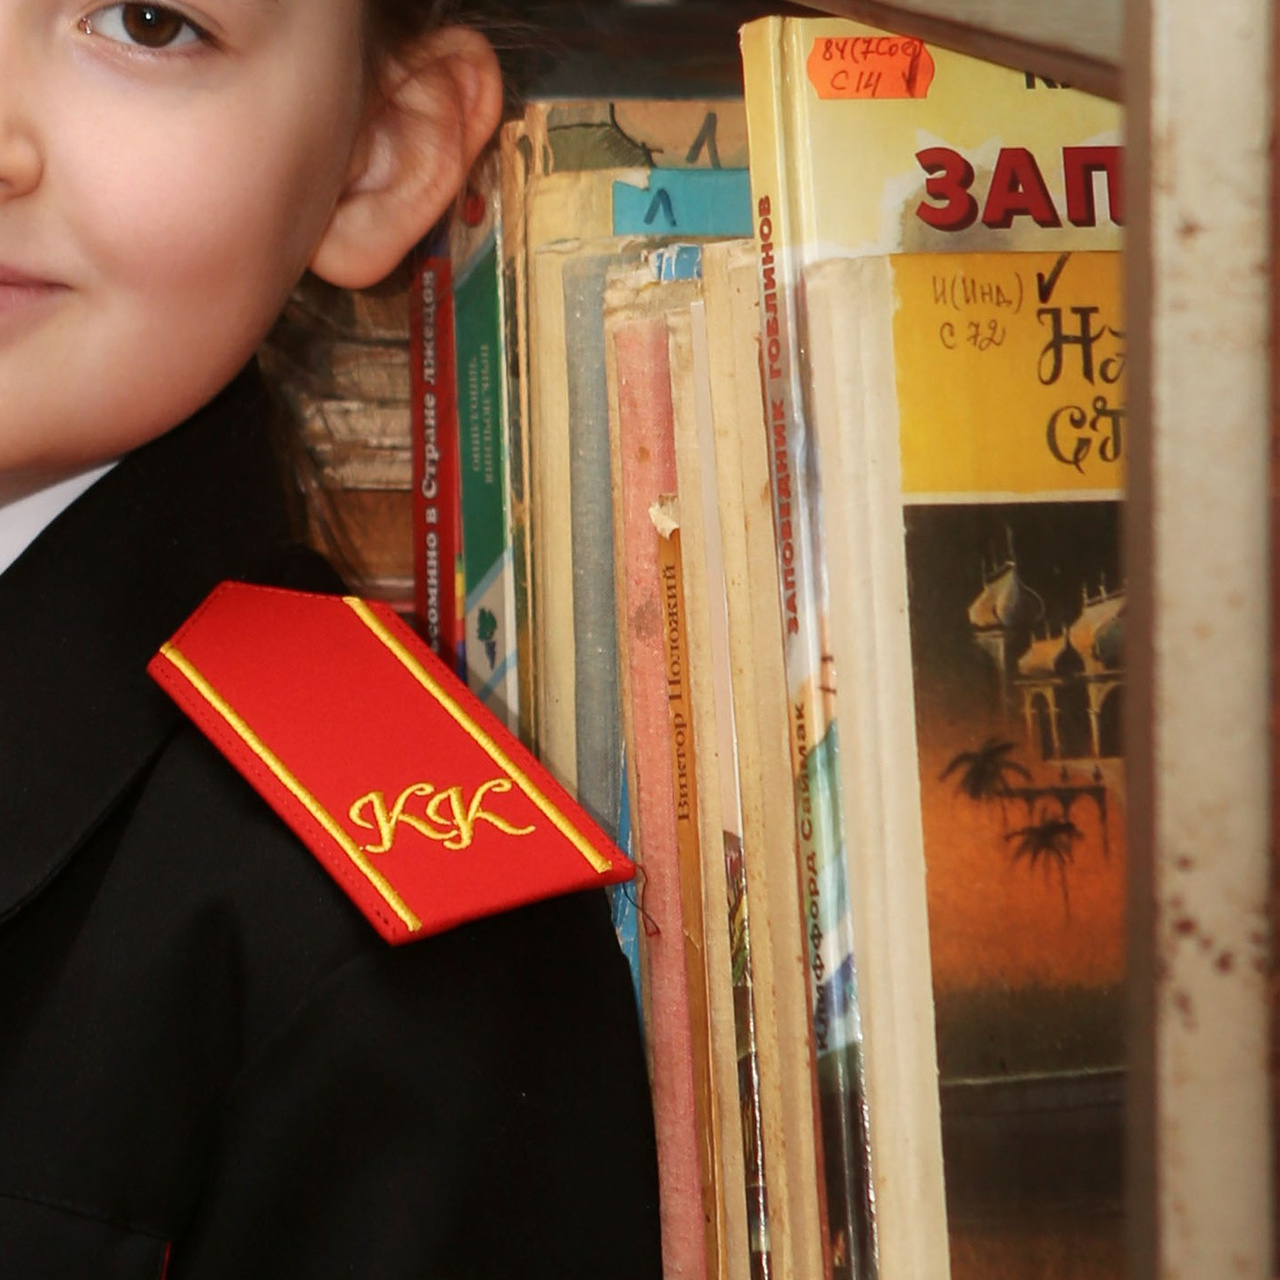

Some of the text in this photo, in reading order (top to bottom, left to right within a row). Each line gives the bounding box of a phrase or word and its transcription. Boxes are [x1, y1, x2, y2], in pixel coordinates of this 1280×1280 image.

[421, 269, 436, 386] лжецов
[756, 193, 800, 638] ЗАПОВЕДНИК ГОБЛИНОВ
[421, 392, 440, 500] Стране
[662, 563, 690, 823] Виктор Положий
[348, 777, 536, 853] КК
[791, 702, 830, 1053] Клиффорд Саймак
